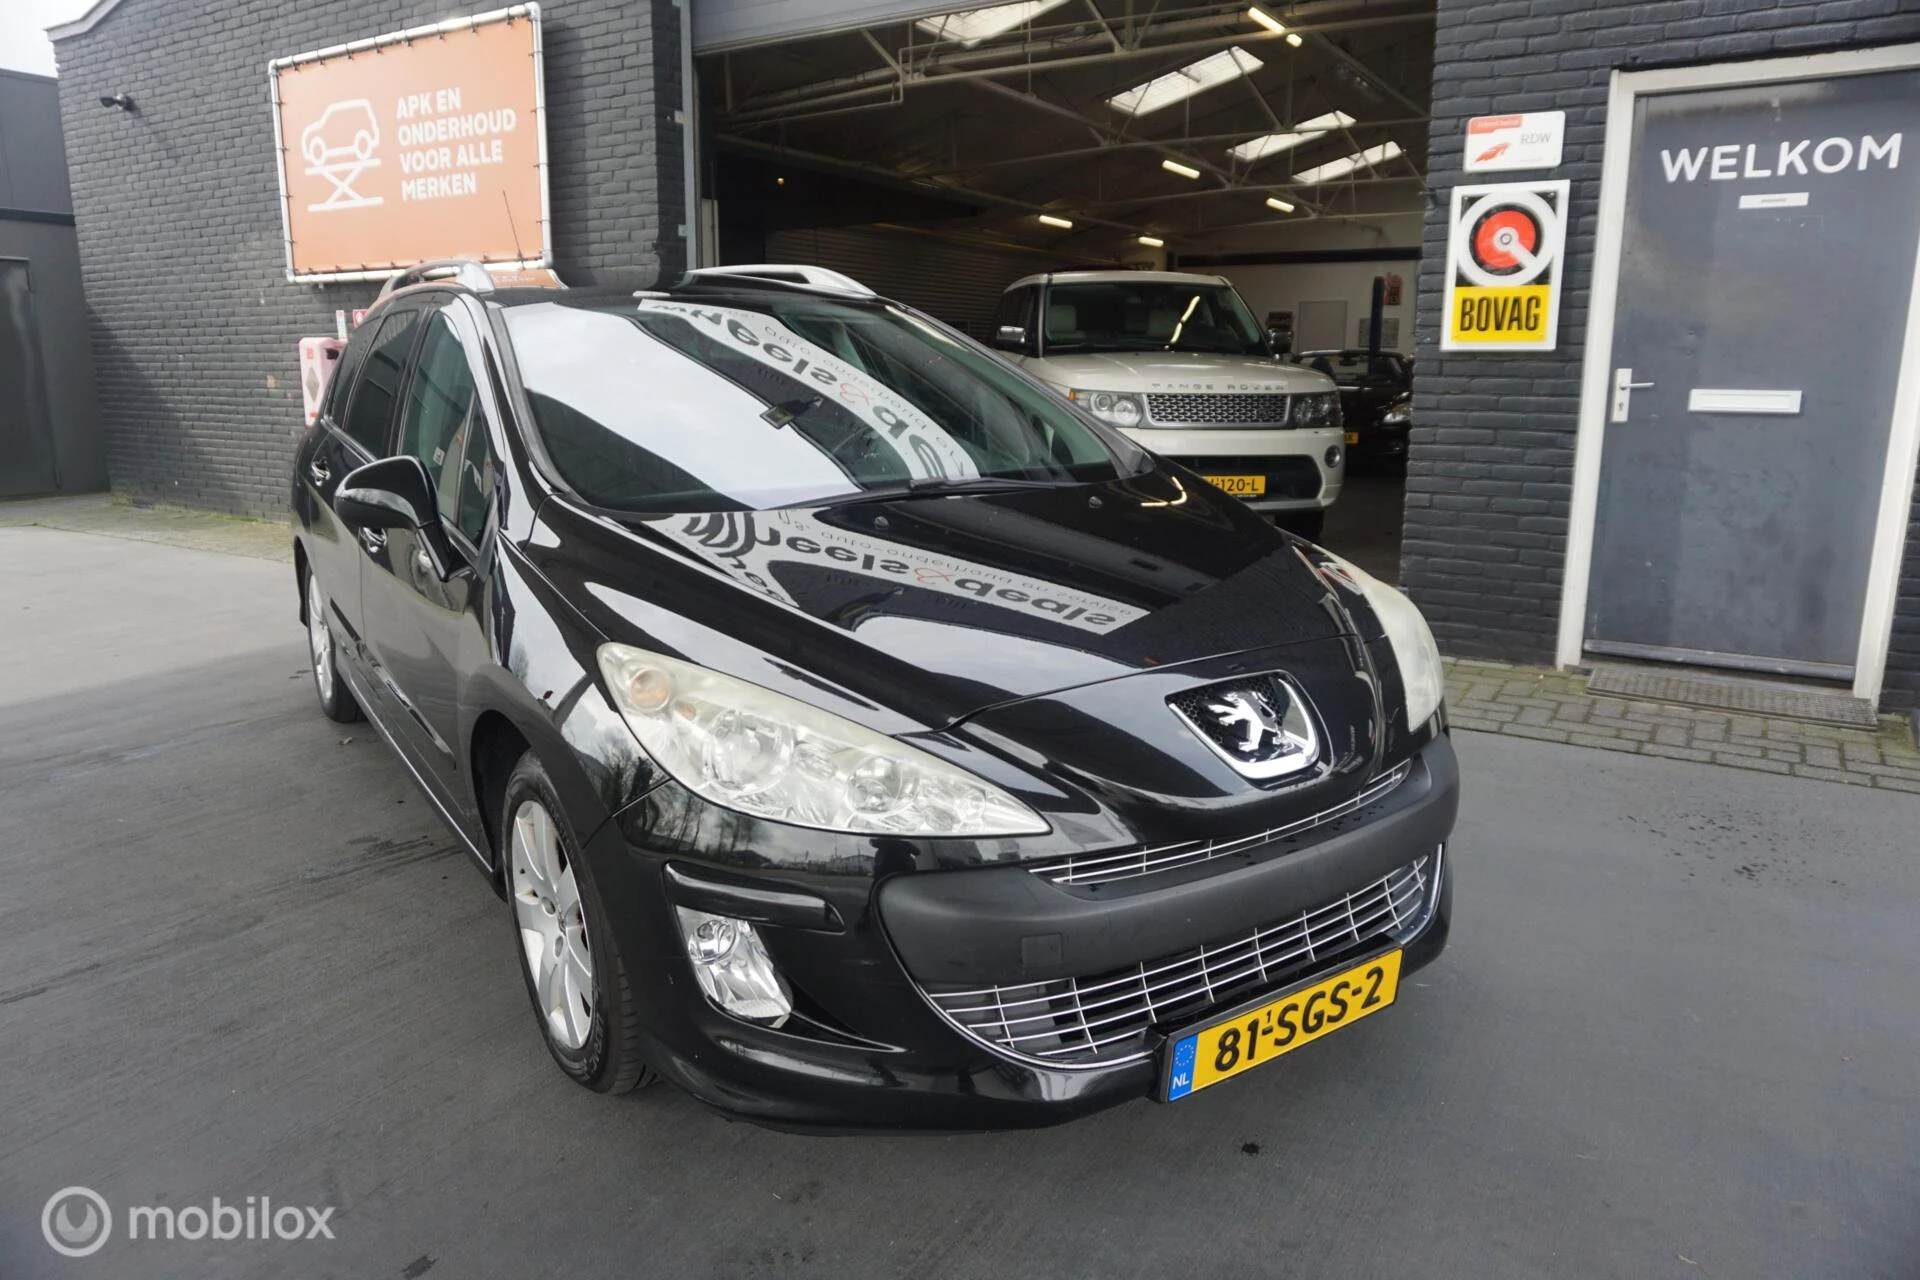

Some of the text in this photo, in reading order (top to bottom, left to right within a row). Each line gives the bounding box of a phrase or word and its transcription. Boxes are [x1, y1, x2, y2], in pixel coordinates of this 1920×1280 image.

[397, 87, 461, 119] APK EN
[398, 108, 516, 146] ONDERHOUD
[1520, 131, 1552, 146] RDW
[400, 139, 503, 174] VOOR ALLE
[1660, 132, 1903, 184] WELKOM
[401, 172, 476, 201] MERKEN
[1459, 295, 1542, 333] BOVAG
[1227, 384, 1285, 392] ROVER
[1215, 966, 1384, 1073] 81-SGS-2
[1172, 1071, 1190, 1090] NL
